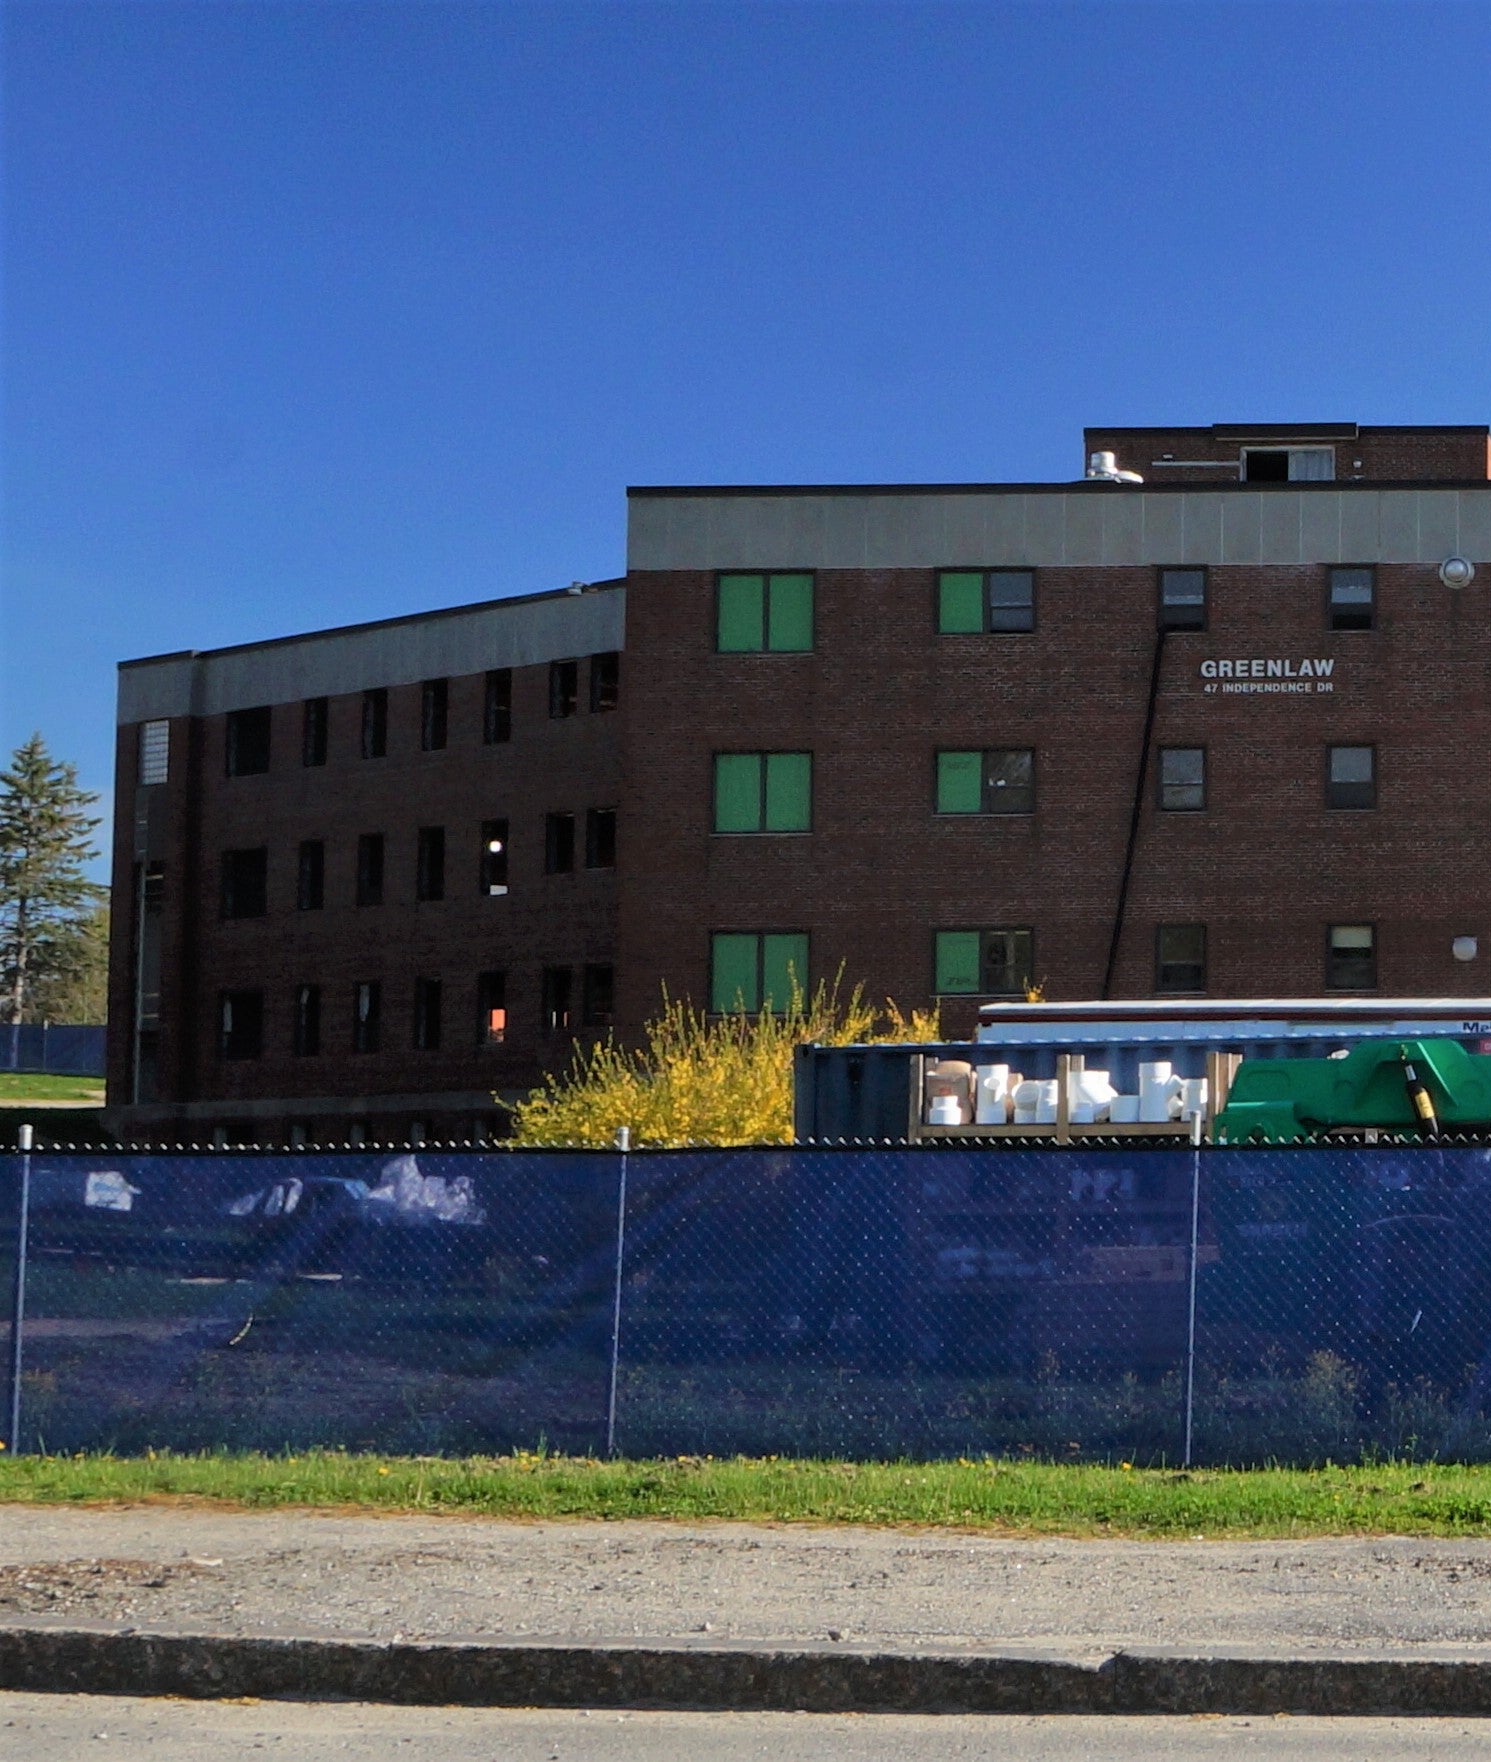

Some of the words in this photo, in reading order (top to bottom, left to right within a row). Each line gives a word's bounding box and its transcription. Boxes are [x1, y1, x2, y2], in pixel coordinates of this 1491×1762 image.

[1200, 659, 1335, 677] GREENLAW
[1204, 683, 1218, 693] 47
[1222, 682, 1312, 693] INDEPENDENCE
[1317, 682, 1334, 692] DR
